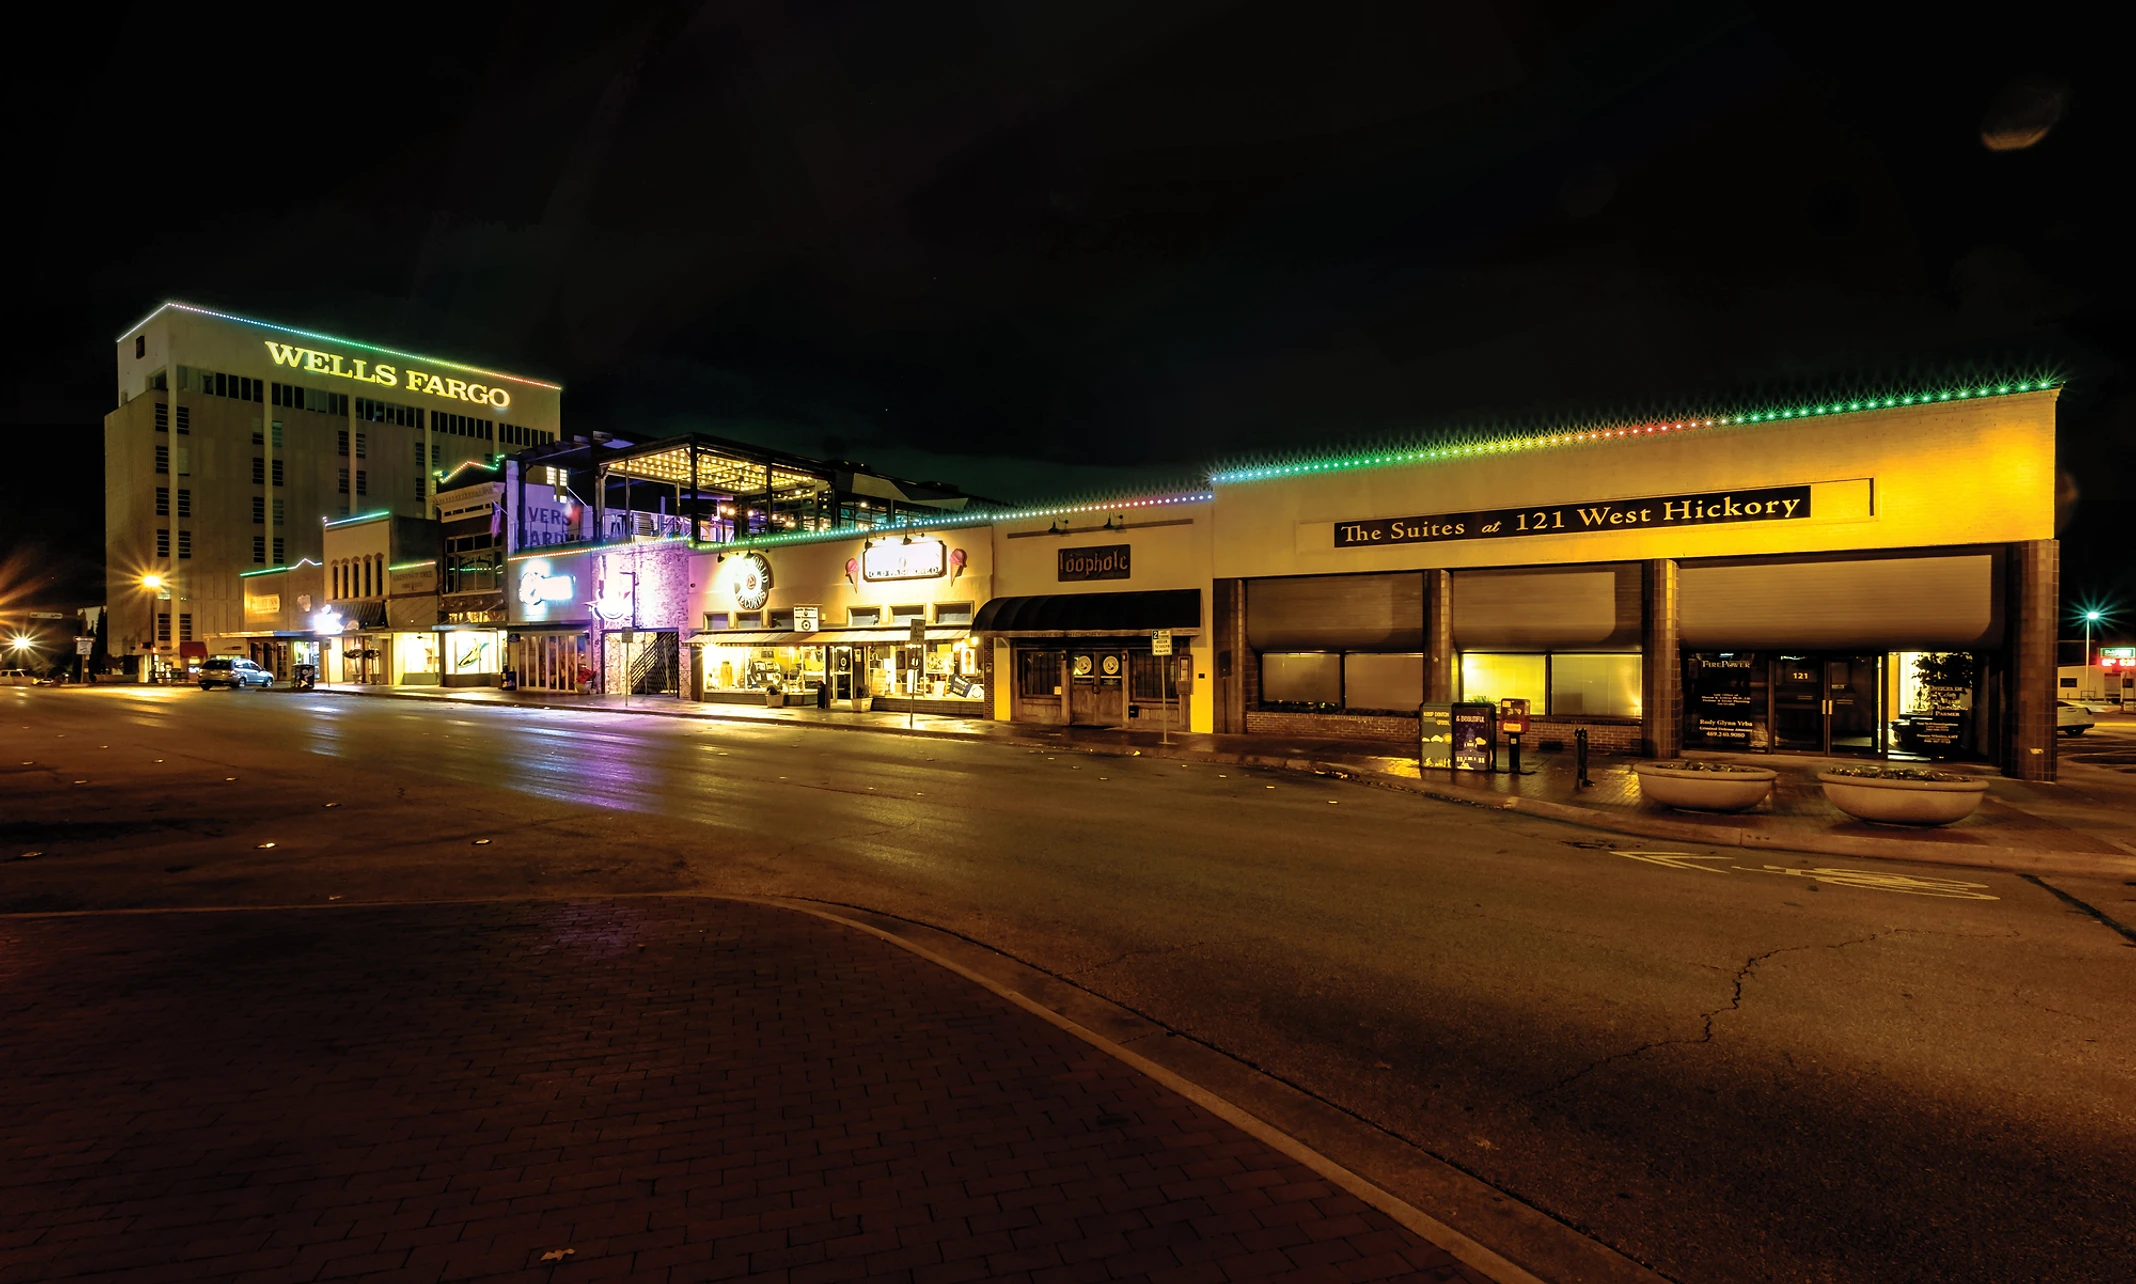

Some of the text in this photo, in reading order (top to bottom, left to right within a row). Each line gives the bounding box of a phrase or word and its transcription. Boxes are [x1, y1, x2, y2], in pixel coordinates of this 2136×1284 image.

[265, 340, 511, 408] WELLS FARGO
[1340, 496, 1801, 543] The Suites at 121 West Hickory
[1153, 631, 1158, 639] 2
[1793, 672, 1809, 680] 121
